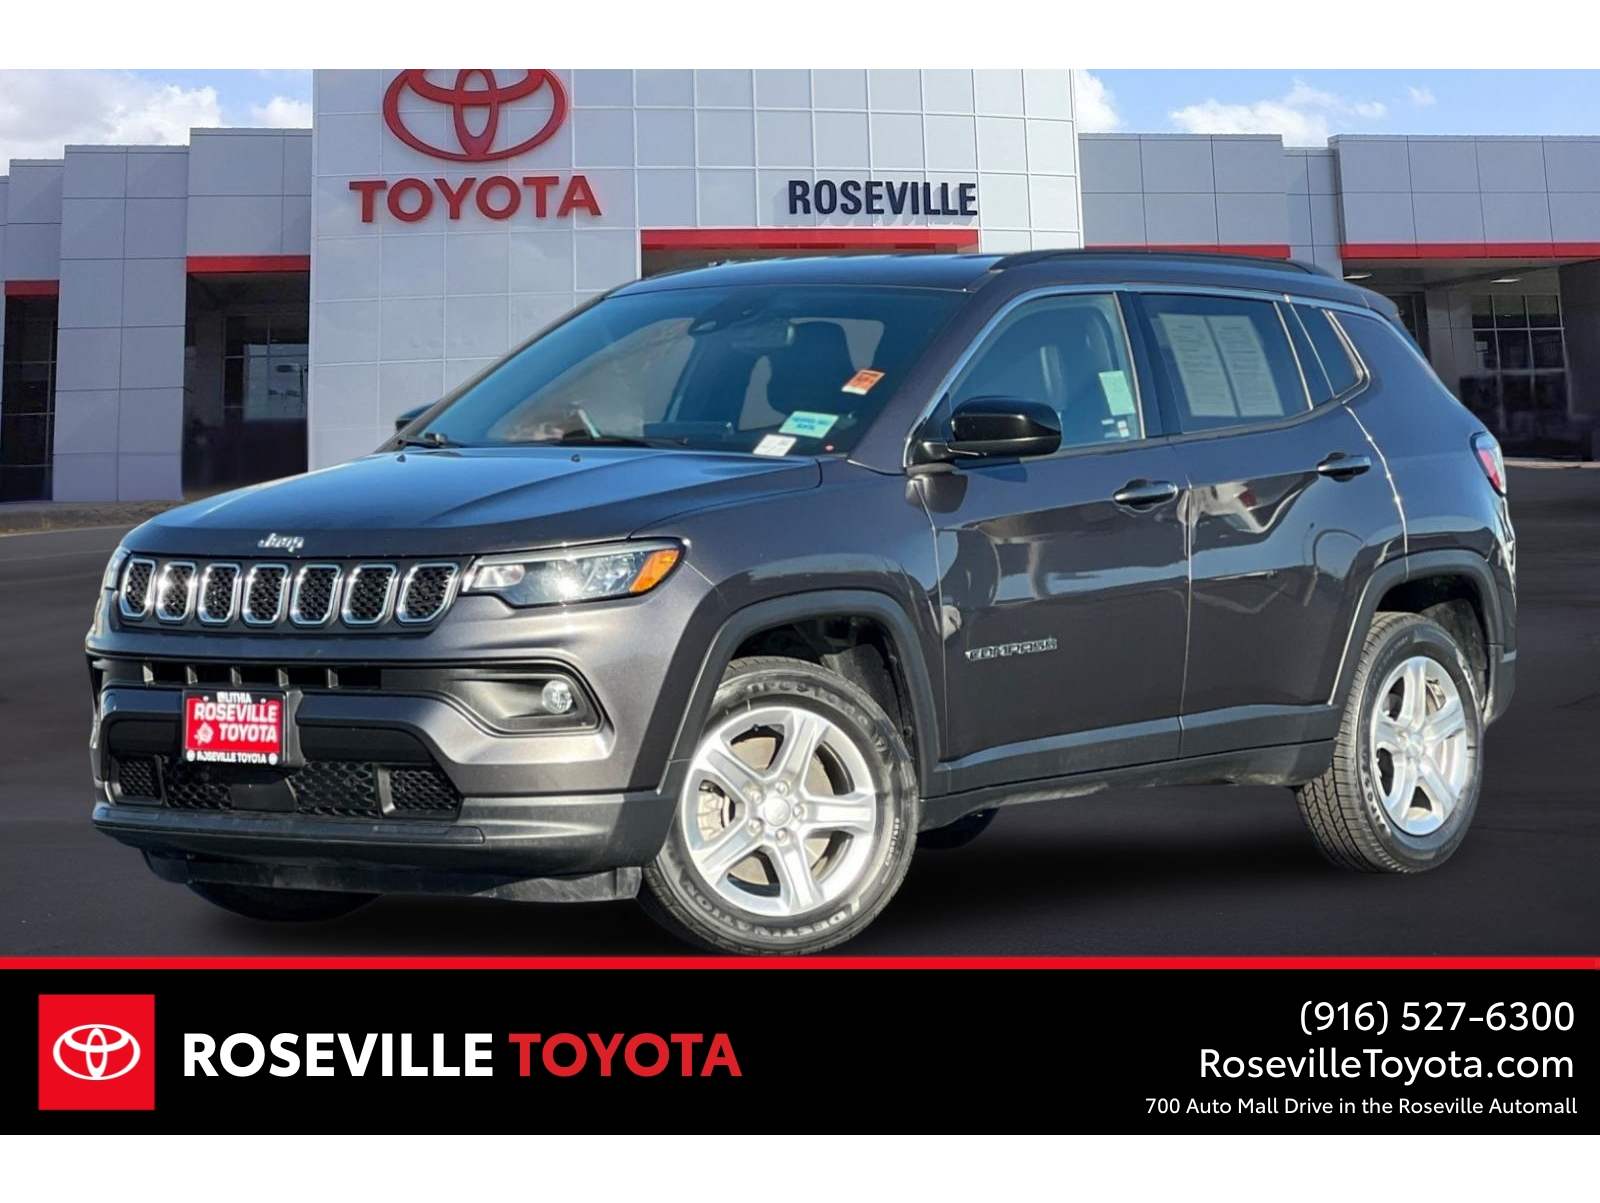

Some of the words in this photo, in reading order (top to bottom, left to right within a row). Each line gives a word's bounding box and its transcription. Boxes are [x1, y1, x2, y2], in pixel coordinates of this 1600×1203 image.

[349, 175, 602, 222] TOYOTA
[788, 179, 978, 216] ROSEVILLE
[257, 532, 305, 553] Jeep
[964, 637, 1058, 661] COMPASS
[193, 703, 279, 723] ROSEVILLE
[218, 722, 279, 744] TOYOTA
[196, 750, 237, 763] ROSEVILLE
[237, 751, 268, 764] TOYOTA
